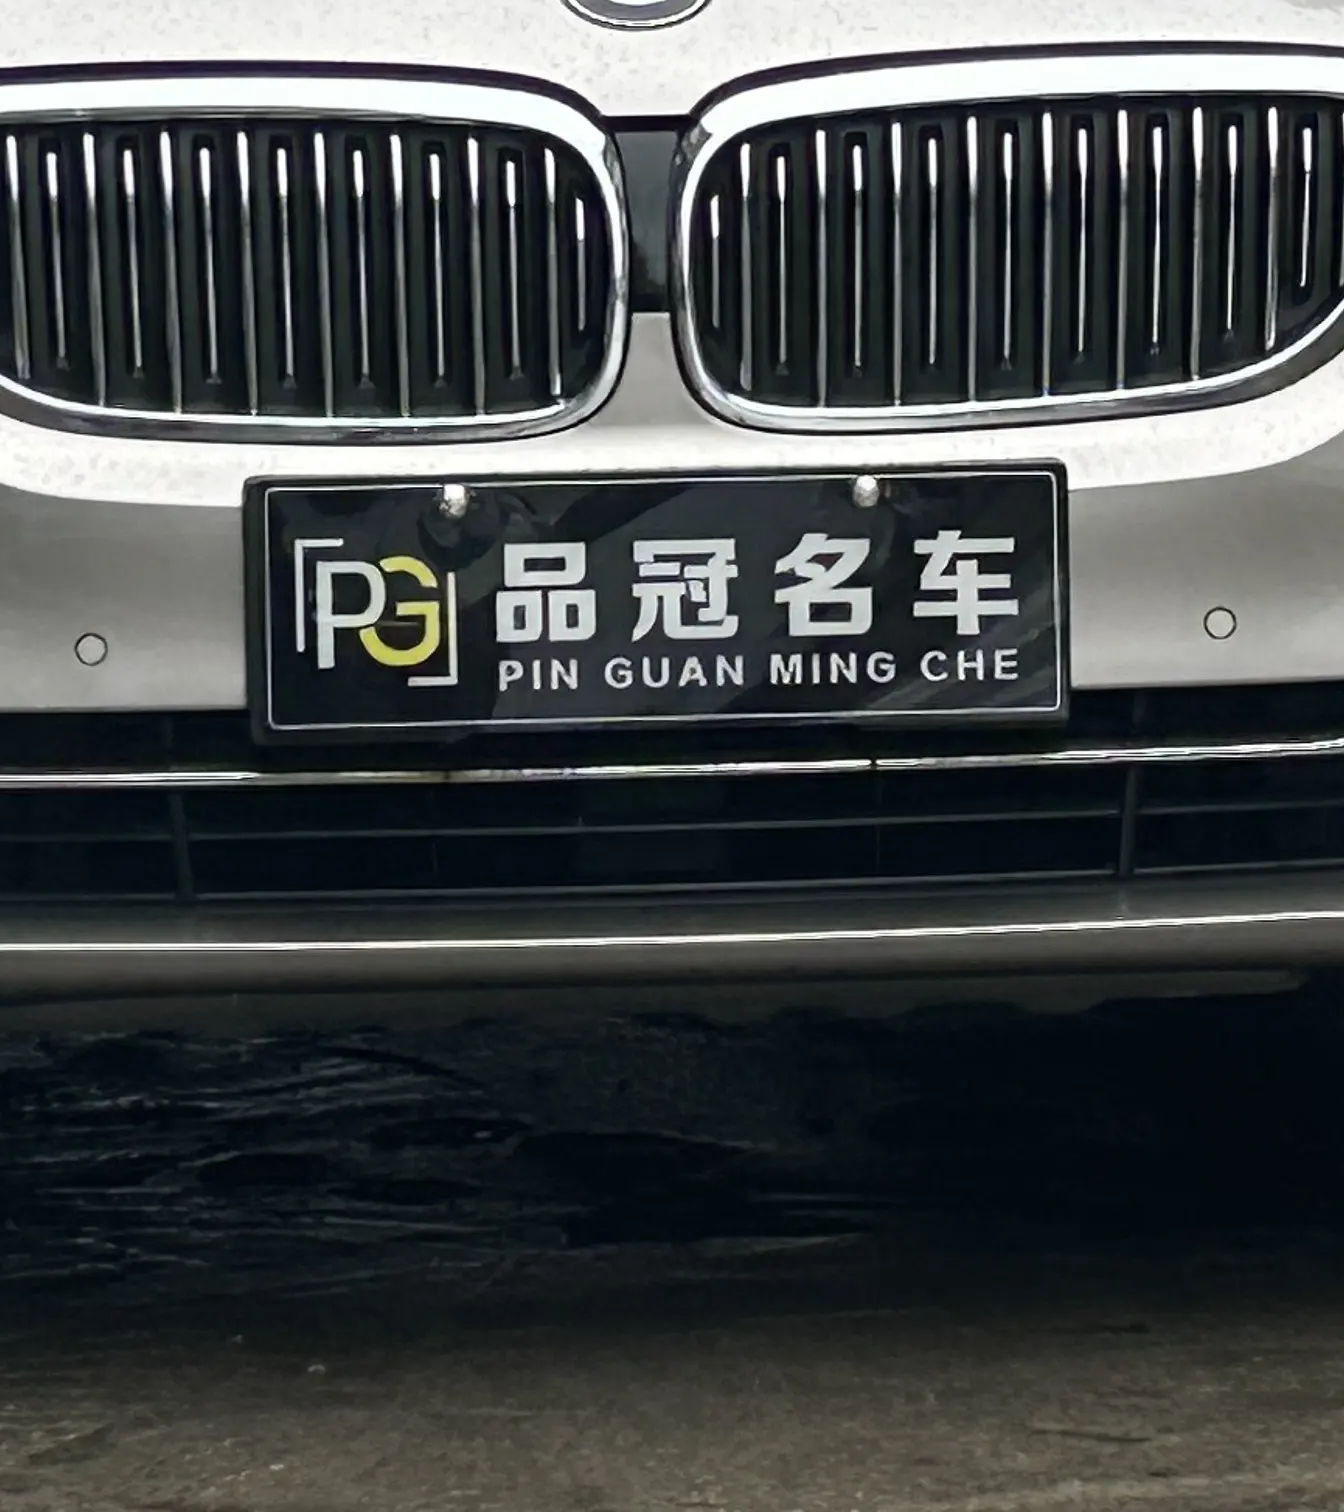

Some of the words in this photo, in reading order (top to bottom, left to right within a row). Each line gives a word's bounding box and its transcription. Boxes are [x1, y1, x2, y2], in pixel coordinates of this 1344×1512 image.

[315, 555, 441, 670] PG
[495, 529, 1020, 643] 品冠名车
[497, 657, 579, 692] PIN
[604, 654, 746, 689] GUAN
[769, 650, 897, 685] MING
[919, 647, 1019, 682] CHE
